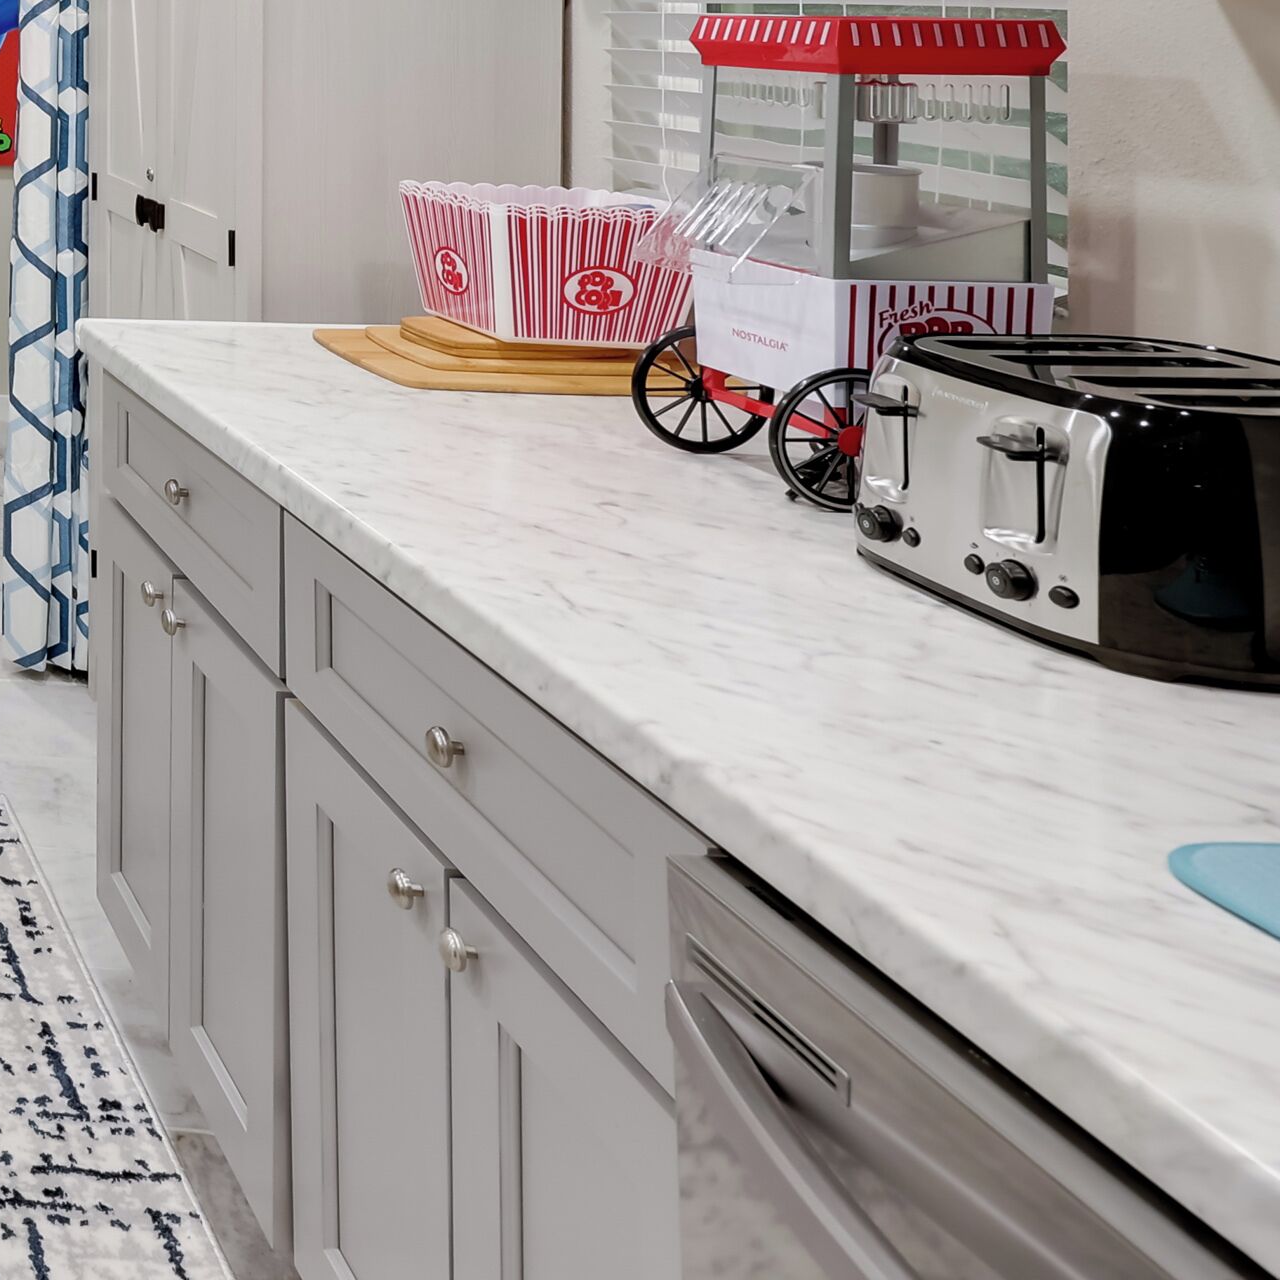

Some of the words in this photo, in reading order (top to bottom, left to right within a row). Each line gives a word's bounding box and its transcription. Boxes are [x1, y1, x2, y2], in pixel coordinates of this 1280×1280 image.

[577, 271, 614, 291] POP
[879, 300, 932, 328] Fresh
[731, 327, 787, 352] NOSTALGIA
